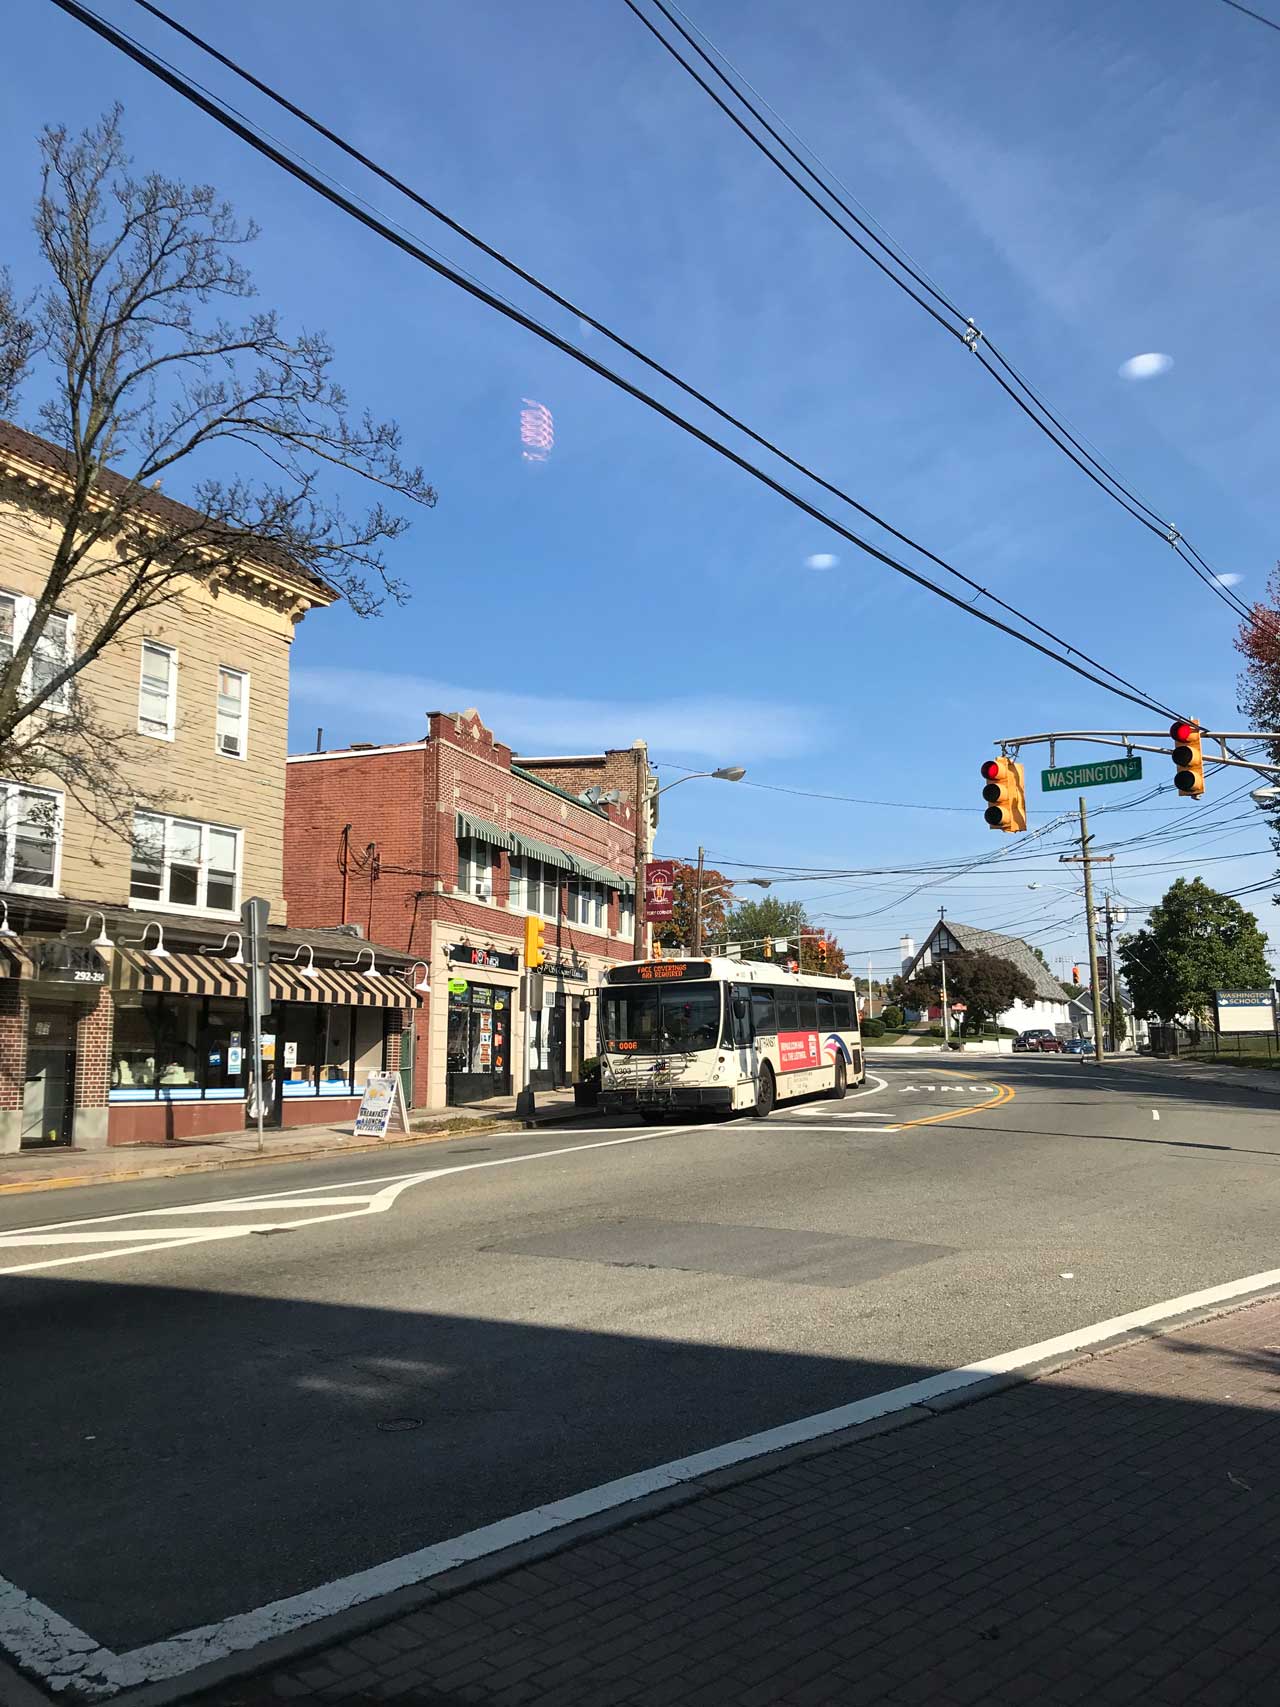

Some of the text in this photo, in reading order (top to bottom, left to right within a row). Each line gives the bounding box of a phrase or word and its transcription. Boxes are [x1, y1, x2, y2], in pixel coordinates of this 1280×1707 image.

[1047, 761, 1137, 787] WASHINGTON ST
[653, 964, 687, 972] COVERINGS
[898, 1085, 994, 1093] ONLY
